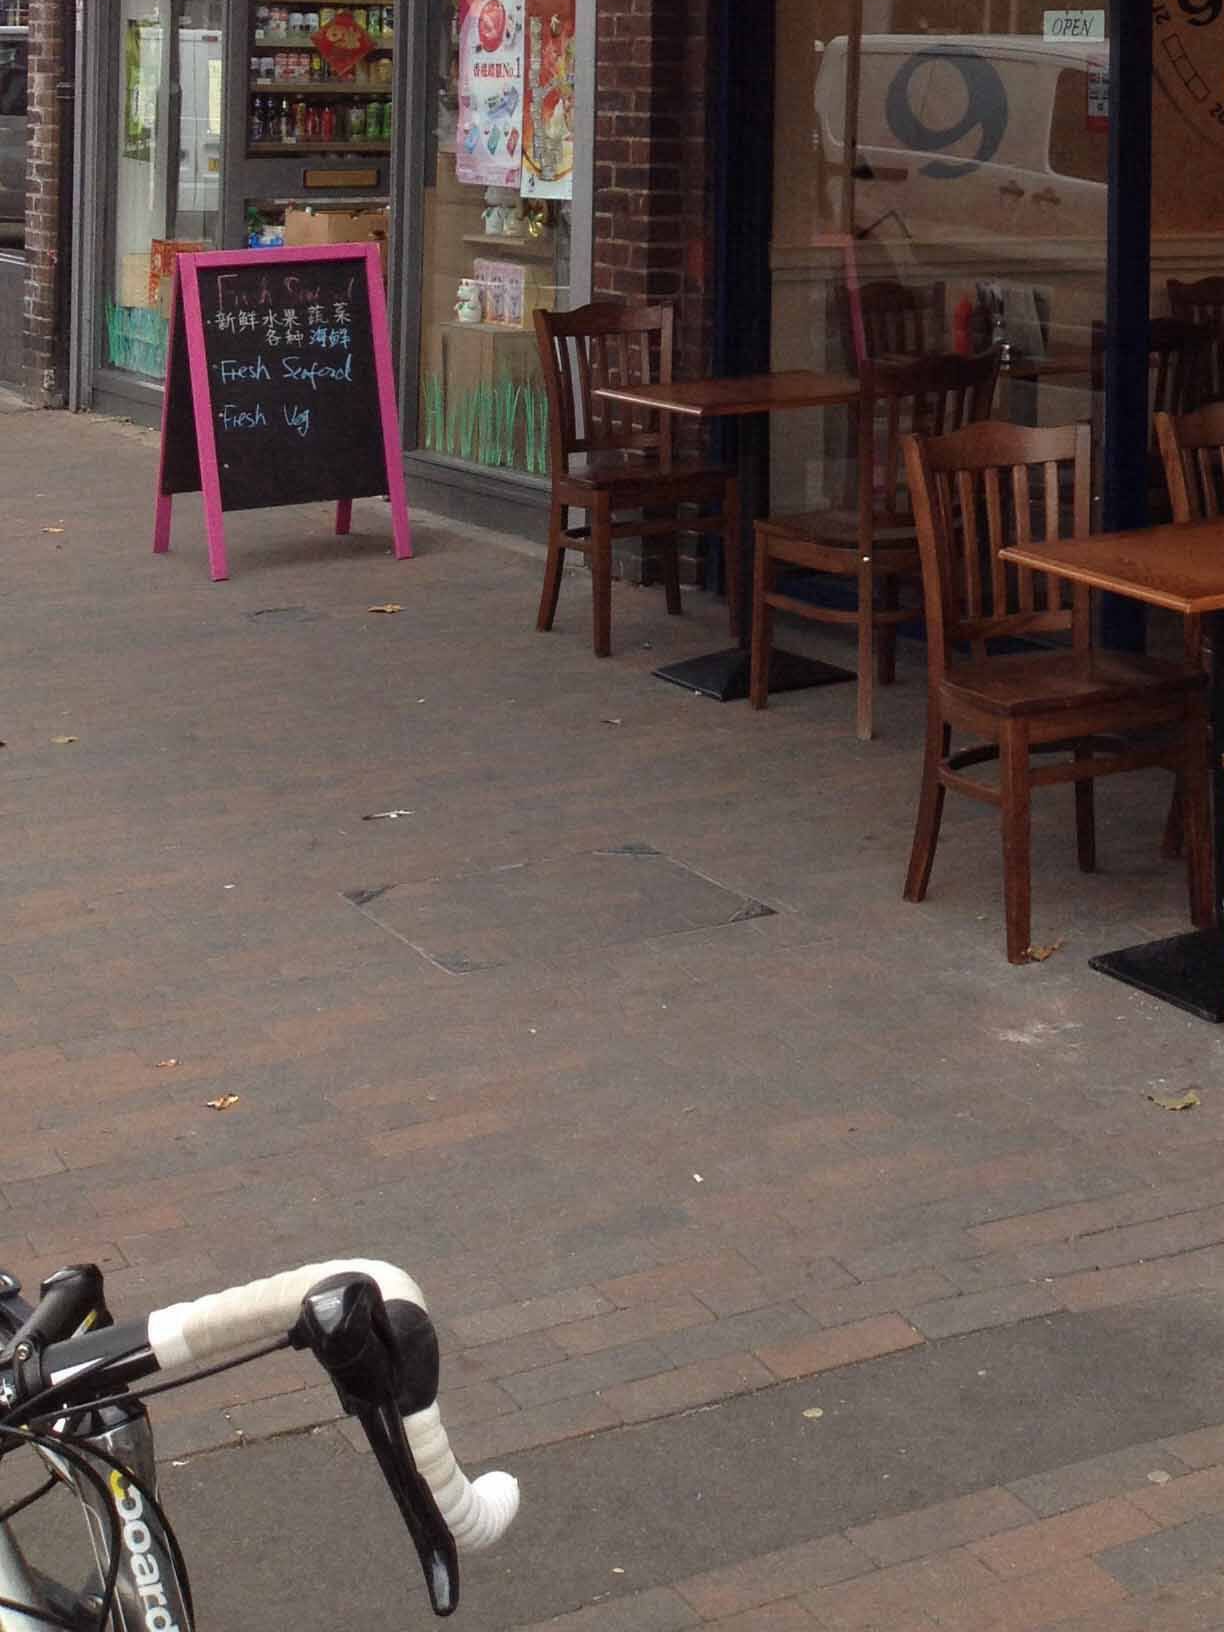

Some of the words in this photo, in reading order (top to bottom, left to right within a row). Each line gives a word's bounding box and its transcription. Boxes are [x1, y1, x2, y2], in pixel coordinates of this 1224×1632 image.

[1051, 14, 1096, 38] OPEN
[885, 44, 1009, 180] 9
[220, 354, 272, 385] Fresh
[222, 403, 267, 431] Fresh
